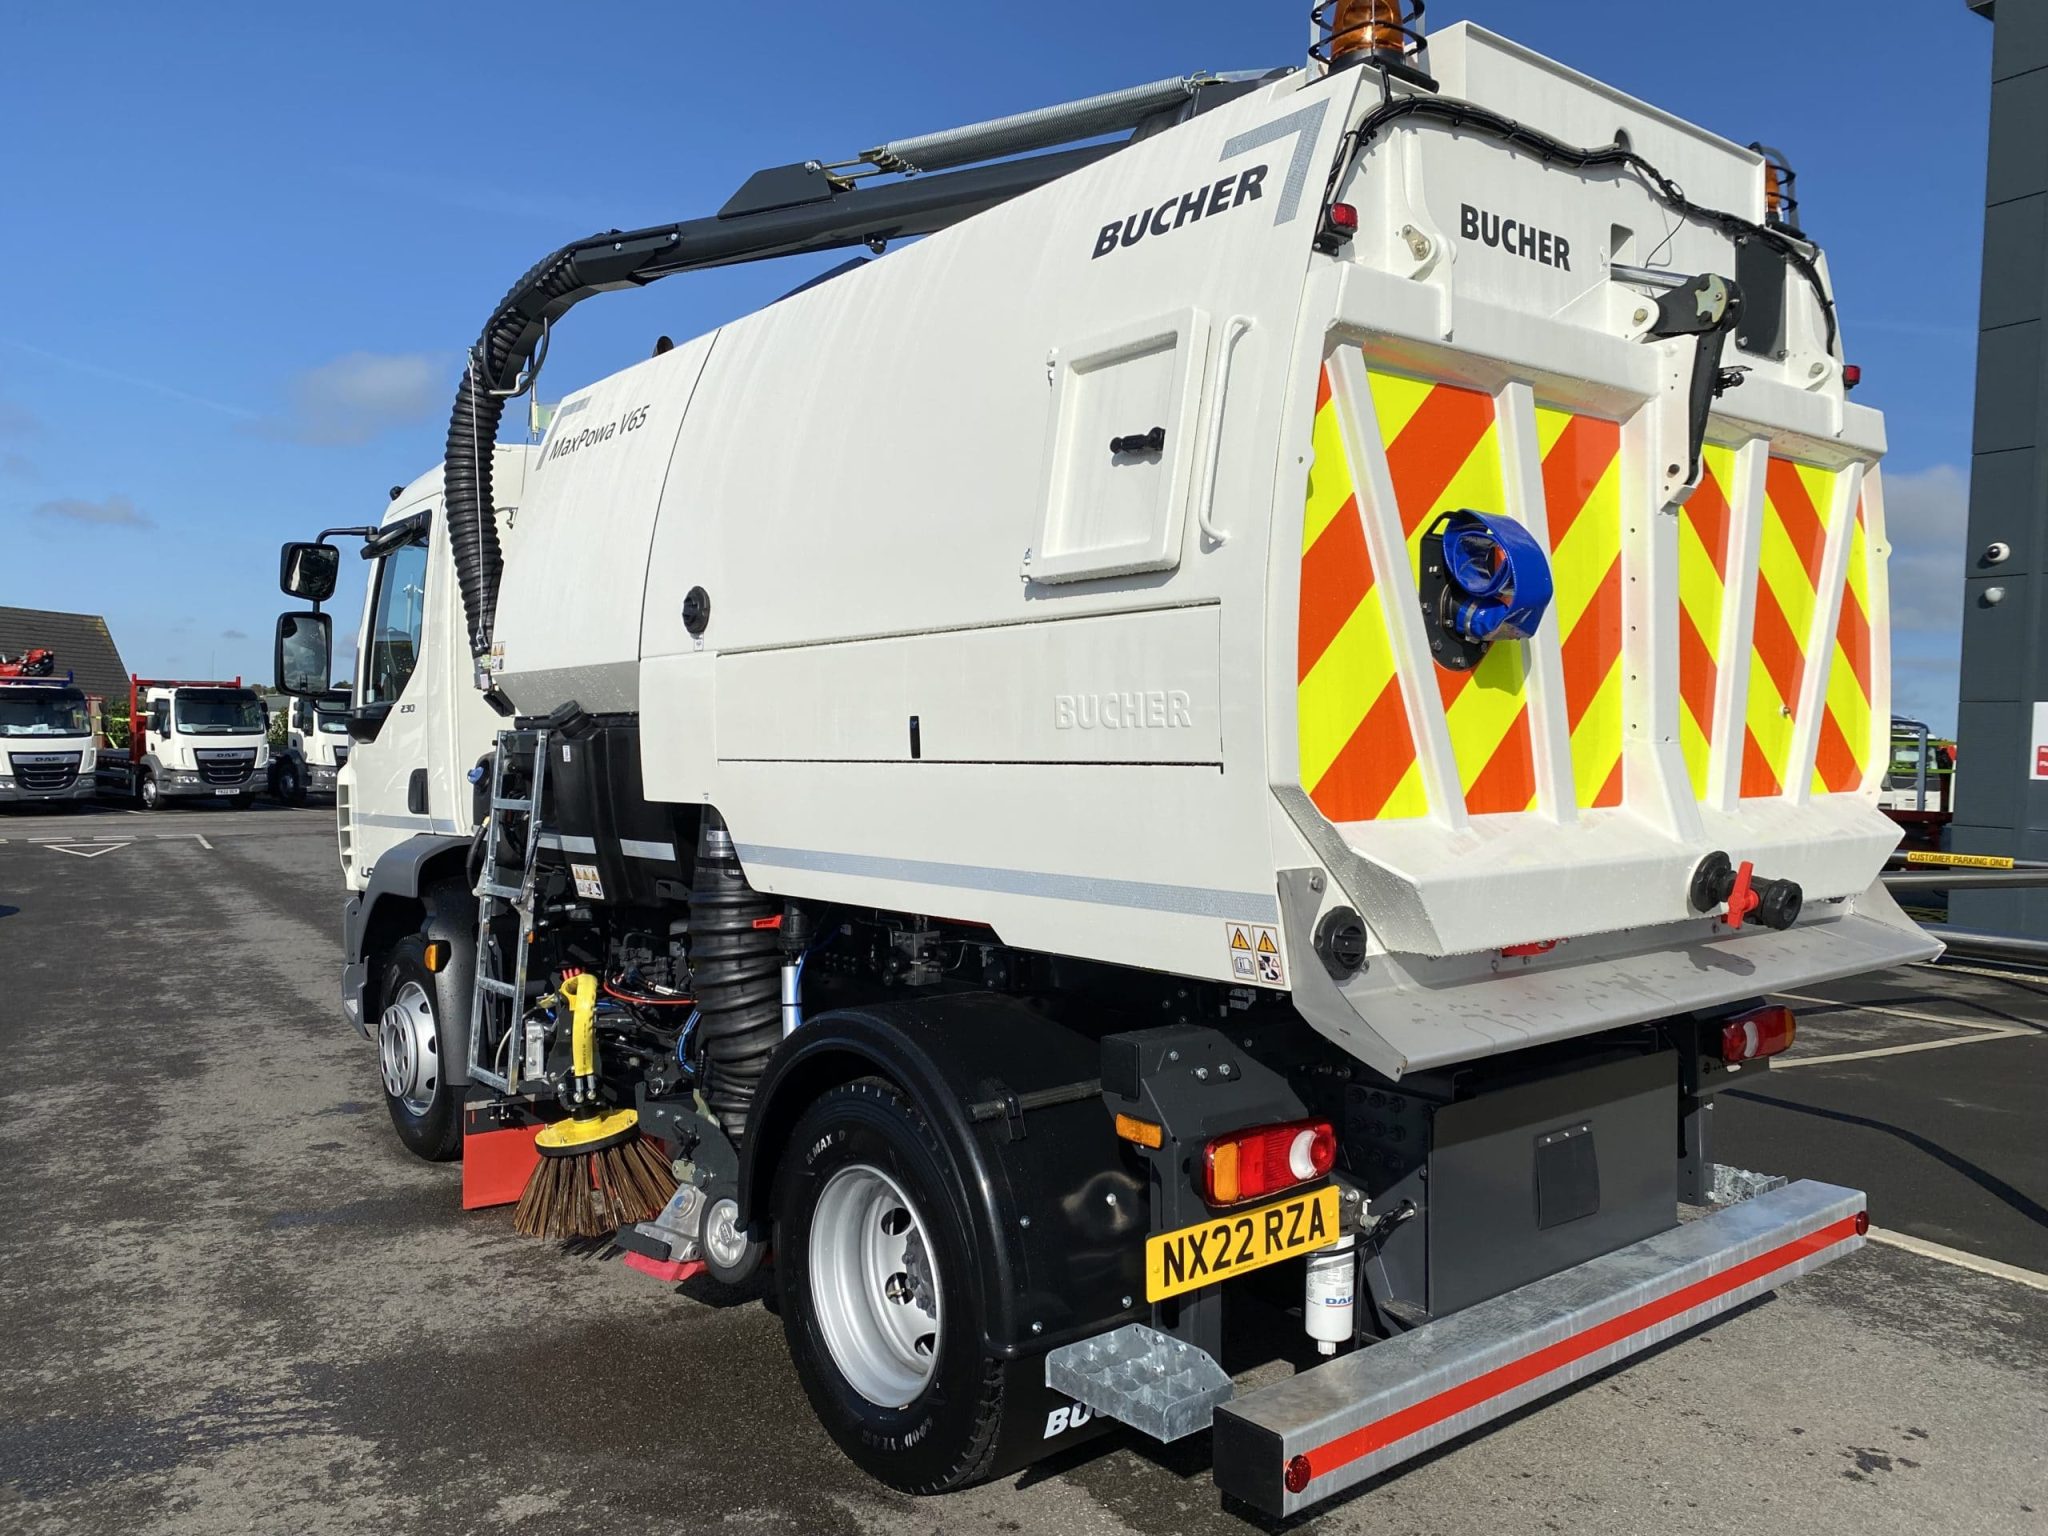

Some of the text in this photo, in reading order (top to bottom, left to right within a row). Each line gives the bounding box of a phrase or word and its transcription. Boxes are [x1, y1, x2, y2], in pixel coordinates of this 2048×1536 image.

[1091, 164, 1269, 260] BUCHER
[1460, 203, 1572, 272] BUCHER
[548, 404, 651, 462] MaxPowa V65
[400, 704, 416, 713] 230
[1055, 690, 1192, 730] BUCHER
[1909, 852, 2010, 868] CUSTOMER PARKING ONLY
[1162, 1219, 1255, 1288] NX22
[1264, 1197, 1327, 1256] RZA
[1043, 1402, 1109, 1440] BU
